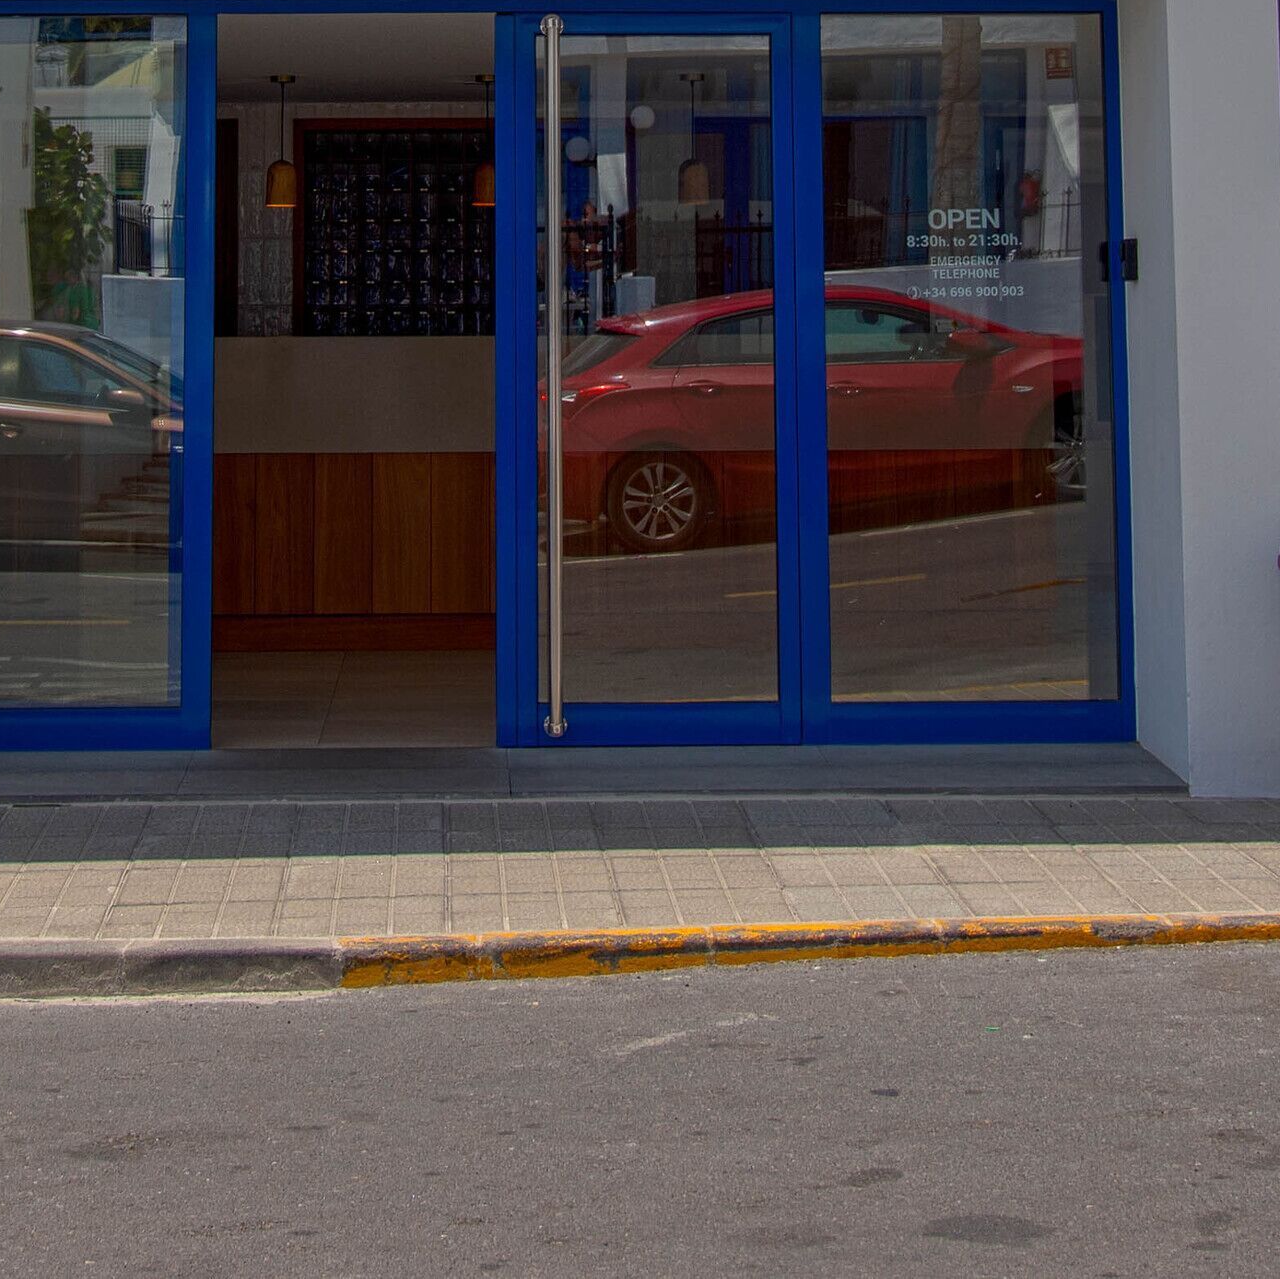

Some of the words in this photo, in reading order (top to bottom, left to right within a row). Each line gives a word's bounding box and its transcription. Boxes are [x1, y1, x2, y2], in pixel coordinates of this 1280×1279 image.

[927, 208, 1001, 230] OPEN
[906, 234, 950, 248] 8:30h.
[953, 236, 966, 247] to
[968, 233, 1023, 247] 21:30h.
[930, 255, 1001, 266] EMERGENCY
[933, 268, 1001, 279] TELEPHONE
[922, 286, 947, 298] +34
[950, 286, 972, 297] 696
[976, 286, 999, 297] 900
[1000, 286, 1024, 297] 903
